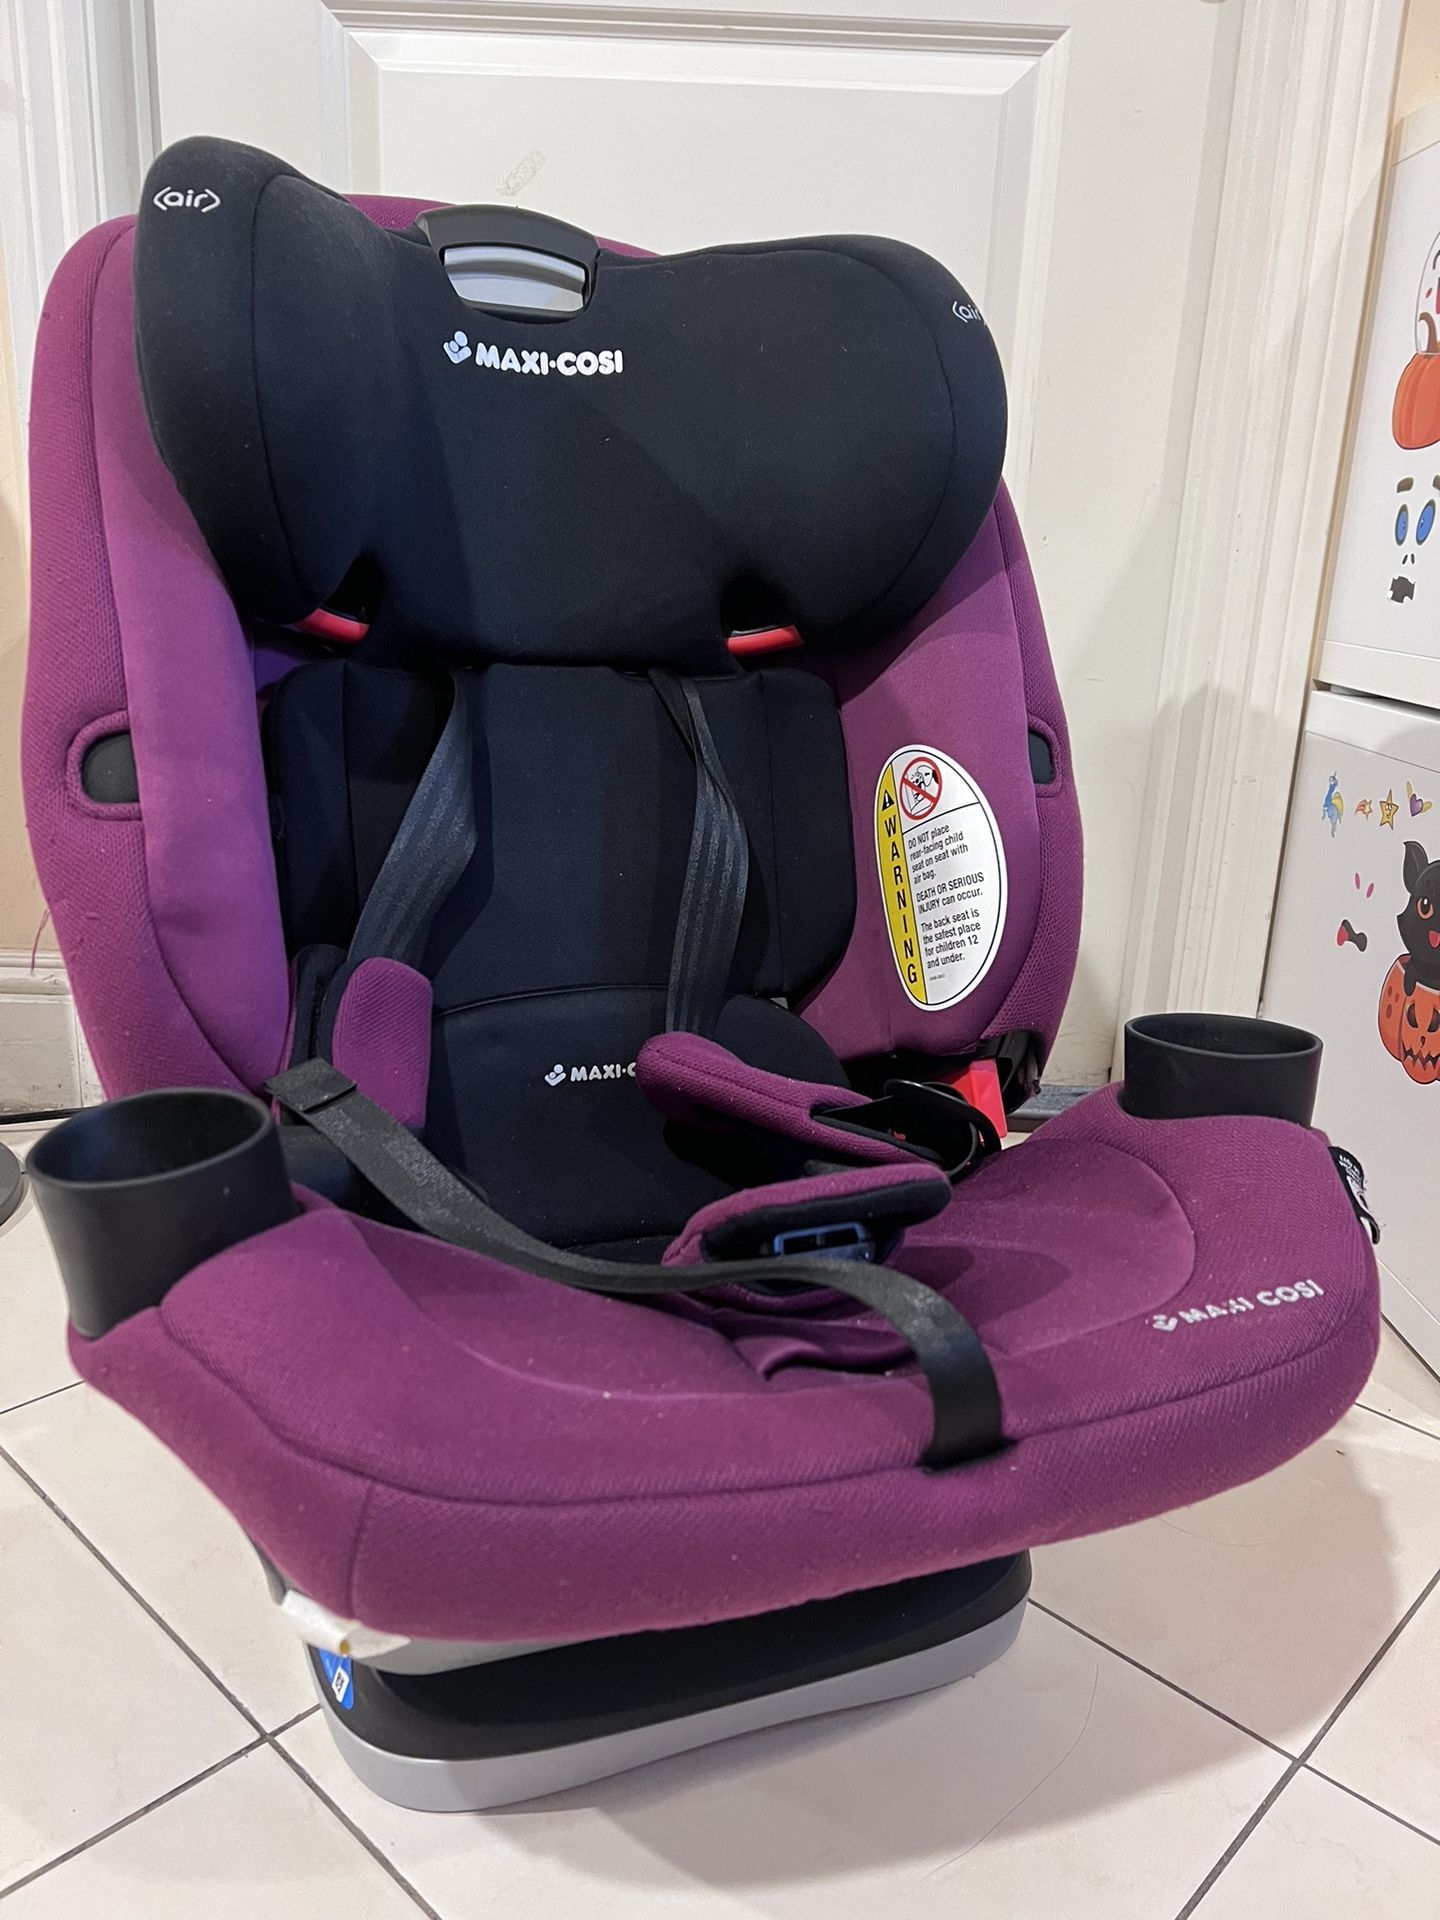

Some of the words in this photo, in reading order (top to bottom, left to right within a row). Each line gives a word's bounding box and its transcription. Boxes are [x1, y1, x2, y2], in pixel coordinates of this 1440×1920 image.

[908, 838, 917, 849] DO
[917, 832, 930, 844] NOT
[930, 824, 950, 839] place
[910, 840, 944, 861] rear-facing
[944, 831, 964, 847] child
[911, 860, 925, 873] seat
[925, 857, 934, 867] on
[934, 850, 950, 863] seat
[950, 843, 969, 856] with
[913, 874, 922, 885] air
[922, 870, 937, 881] bag.
[916, 887, 936, 902] DEATH
[936, 883, 948, 894] OR
[948, 871, 985, 890] SERIOUS
[885, 815, 917, 983] WARNING
[919, 898, 940, 914] INJURY
[941, 895, 956, 906] can
[956, 887, 984, 901] occur.
[921, 922, 933, 932] The
[933, 915, 951, 928] back
[951, 910, 970, 923] seat
[970, 908, 980, 917] is
[923, 935, 934, 945] the
[934, 928, 957, 941] safest
[957, 922, 981, 937] place
[925, 947, 935, 957] for
[935, 938, 967, 953] children
[967, 934, 980, 946] 12
[927, 958, 940, 969] and
[941, 953, 966, 965] under.
[1256, 1279, 1325, 1307] COSI
